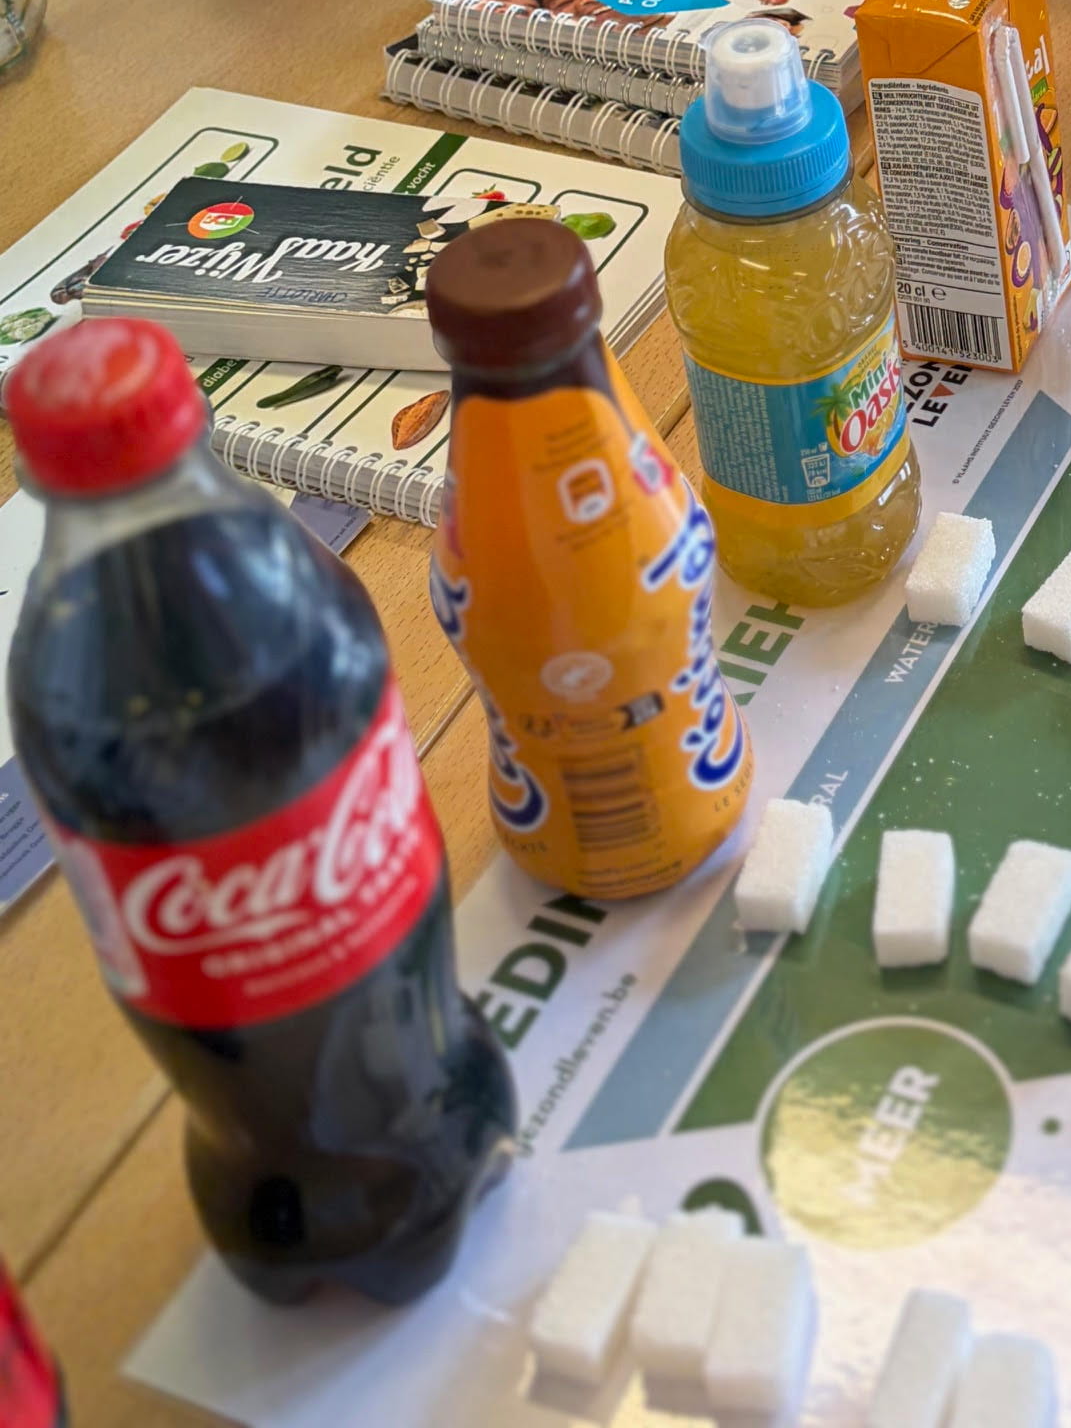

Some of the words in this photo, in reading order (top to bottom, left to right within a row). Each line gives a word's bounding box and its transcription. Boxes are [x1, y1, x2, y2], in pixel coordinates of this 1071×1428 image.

[320, 145, 383, 191] eld
[362, 155, 401, 193] ciëntie
[407, 160, 436, 194] vocht
[896, 281, 912, 295] 20
[915, 285, 926, 297] cl
[203, 358, 237, 388] diabe
[884, 620, 942, 684] WATER
[836, 1065, 941, 1206] MEER
